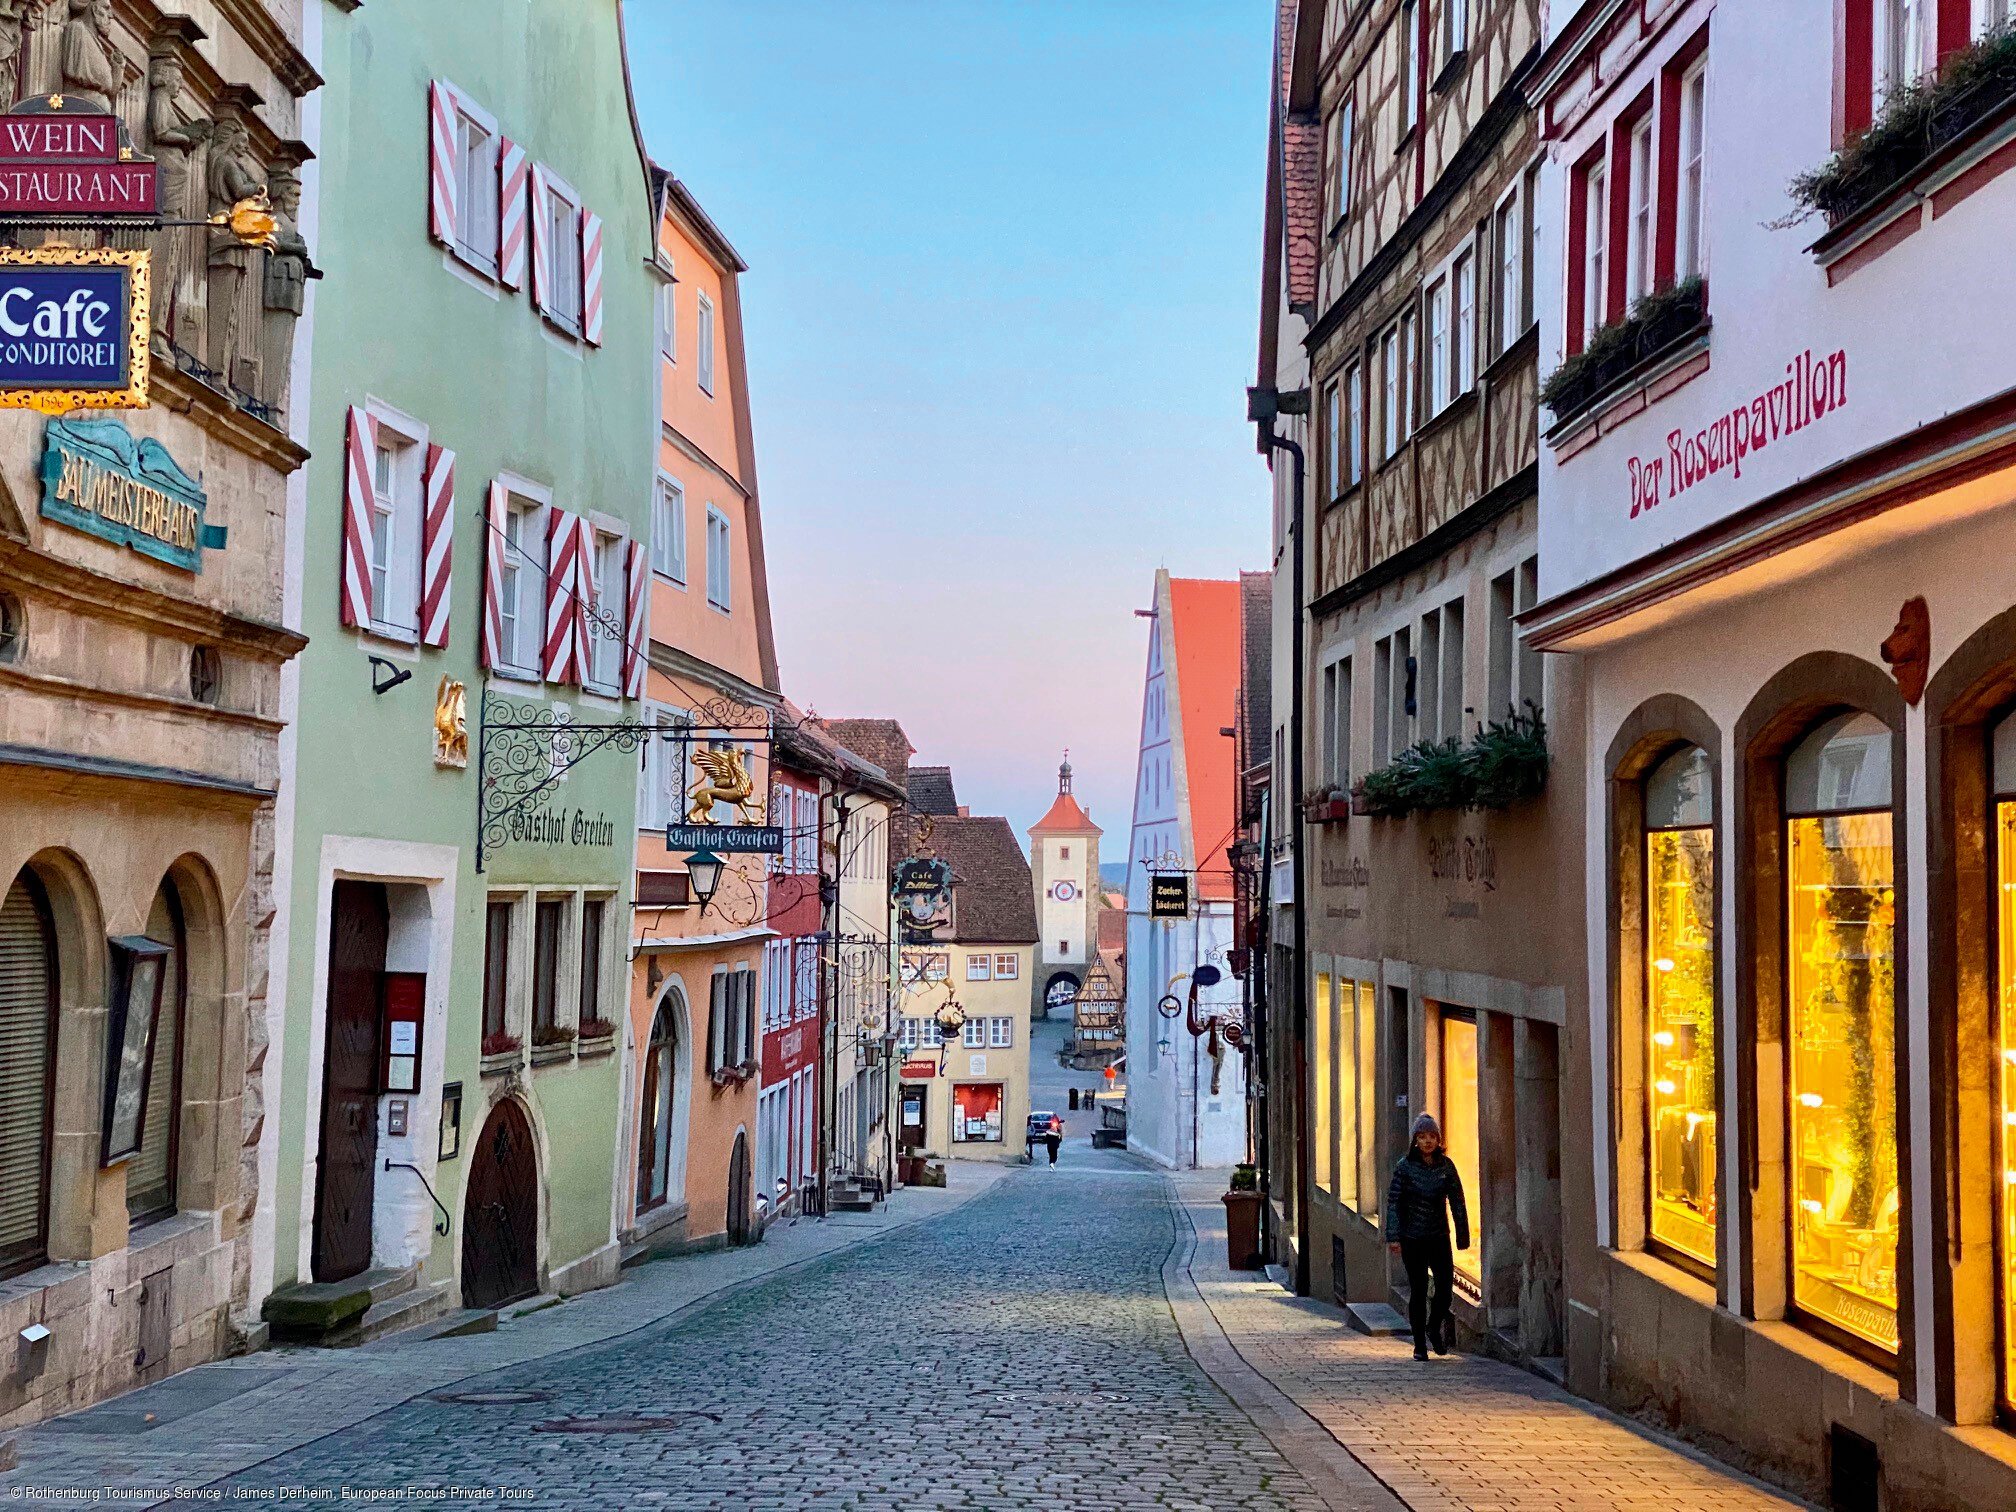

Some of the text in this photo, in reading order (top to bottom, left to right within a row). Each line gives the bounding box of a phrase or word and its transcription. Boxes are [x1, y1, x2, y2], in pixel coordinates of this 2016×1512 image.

[6, 124, 105, 153] WEIN
[0, 286, 111, 339] Cafe
[0, 342, 115, 368] ONDITOREI
[1628, 349, 1847, 520] Der Rosenpavillon
[56, 447, 198, 552] BAUMEISTERHAUS
[512, 805, 567, 851] Gasthof
[911, 871, 932, 880] Cafe
